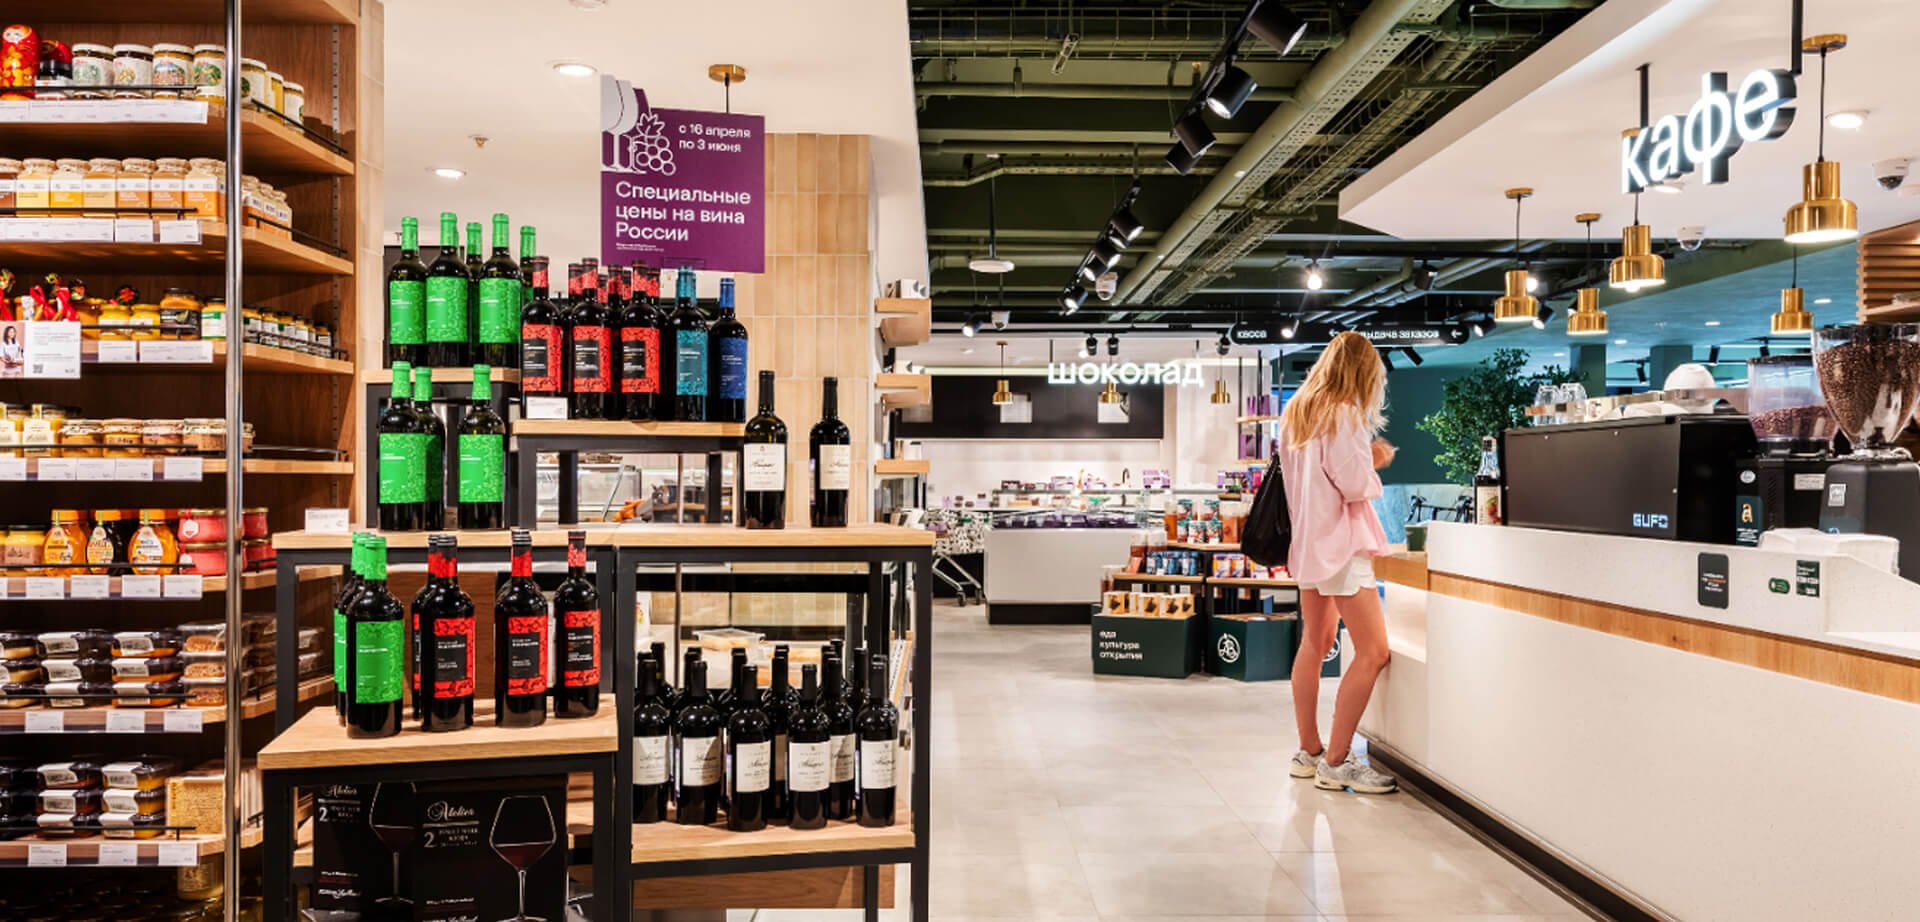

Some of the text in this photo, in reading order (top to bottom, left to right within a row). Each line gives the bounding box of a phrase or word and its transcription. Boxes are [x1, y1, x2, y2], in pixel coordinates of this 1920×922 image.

[679, 123, 751, 139] с 16 апреля
[1621, 68, 1784, 194] кафе
[678, 139, 742, 153] по 3 июня
[615, 180, 752, 205] Специальные
[615, 205, 745, 224] цены на вина
[615, 221, 689, 242] России
[1236, 329, 1268, 339] касса
[1048, 361, 1205, 388] шоколад
[1632, 512, 1669, 529] GUFO
[1099, 641, 1141, 650] культура
[1099, 651, 1143, 661] открытия
[319, 806, 328, 822] 2
[424, 832, 435, 848] 2
